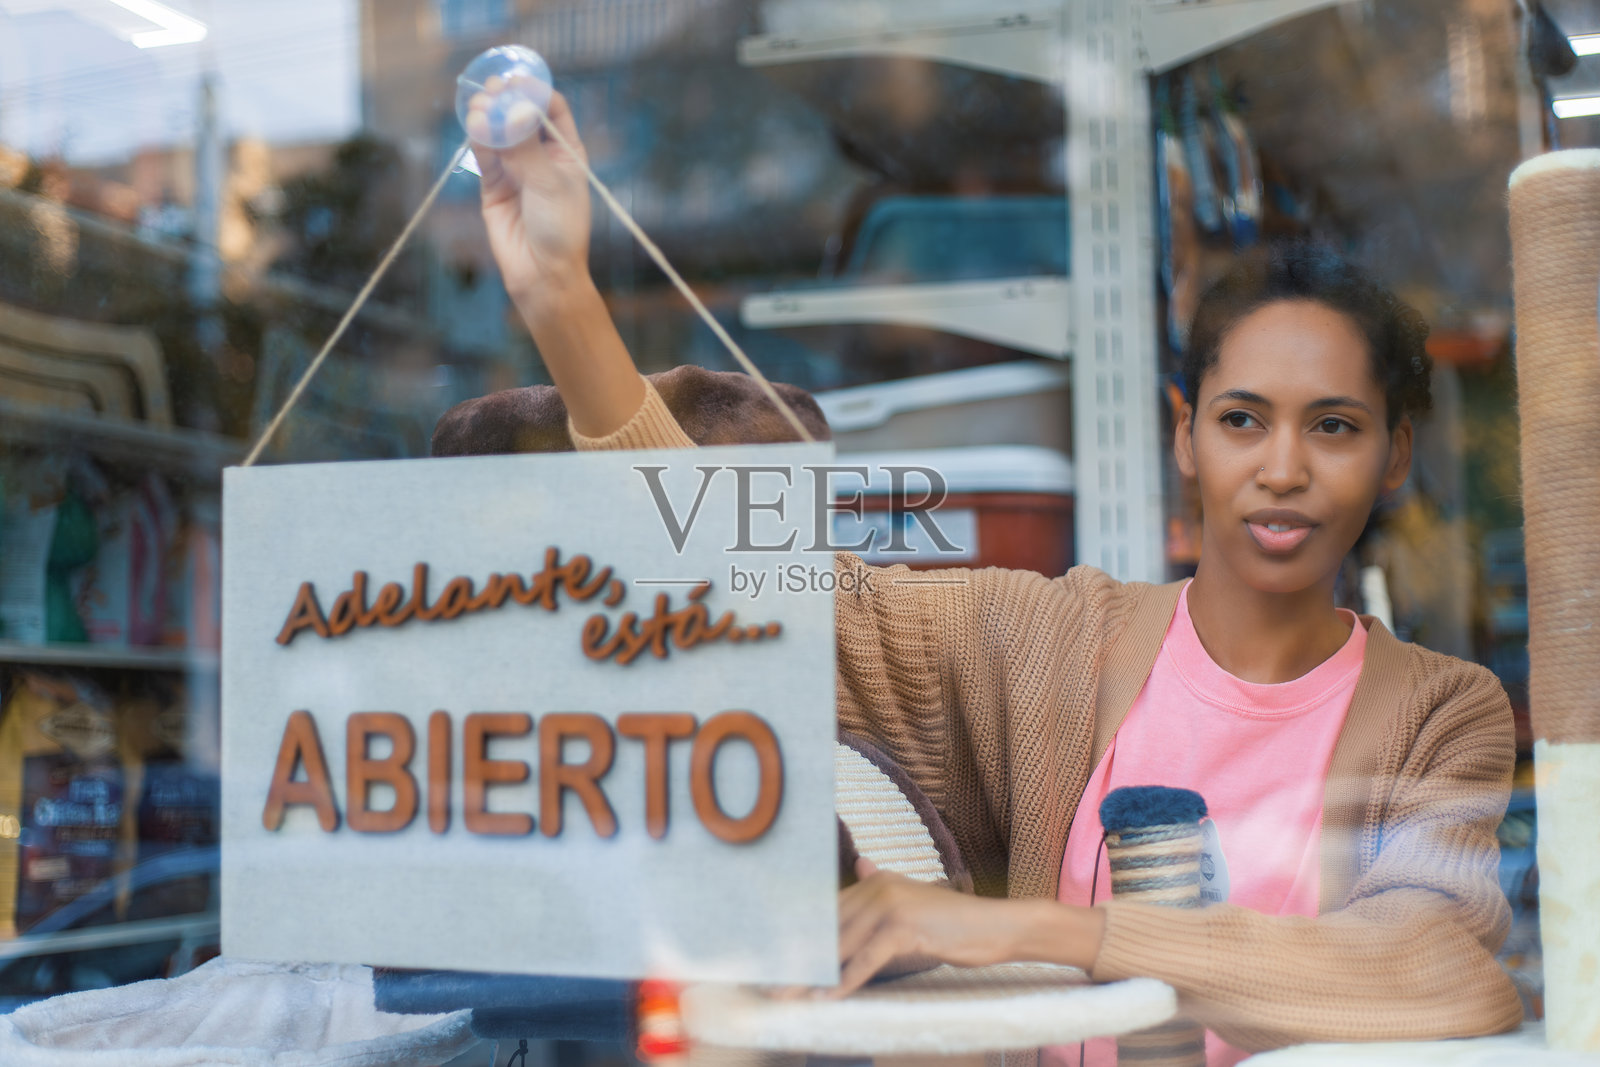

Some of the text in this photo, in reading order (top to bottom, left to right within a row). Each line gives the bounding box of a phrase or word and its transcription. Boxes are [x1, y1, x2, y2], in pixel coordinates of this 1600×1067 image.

[276, 547, 627, 645] Adelante,
[582, 582, 782, 664] está...
[262, 710, 784, 844] ABIERTO
